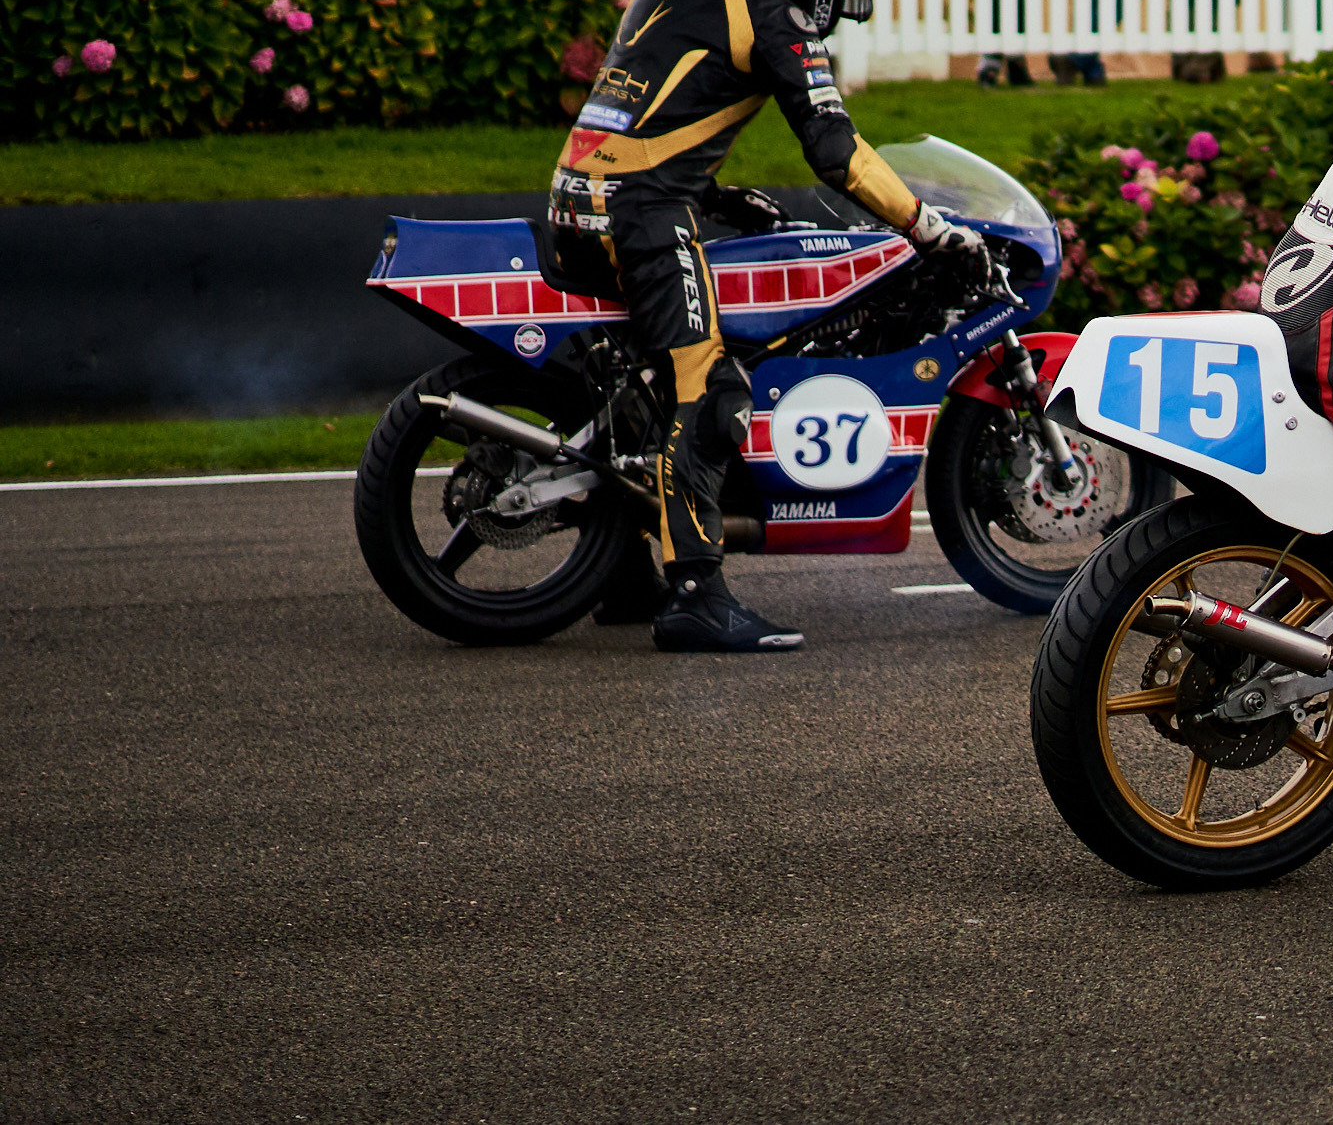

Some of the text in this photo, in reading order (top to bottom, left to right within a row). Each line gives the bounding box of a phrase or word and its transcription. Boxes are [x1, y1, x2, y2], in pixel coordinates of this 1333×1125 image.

[799, 236, 852, 252] YAMAHA
[966, 306, 1015, 341] BRENMAR
[1129, 338, 1239, 440] 15
[794, 412, 869, 468] 37
[771, 501, 837, 519] YAMAHA
